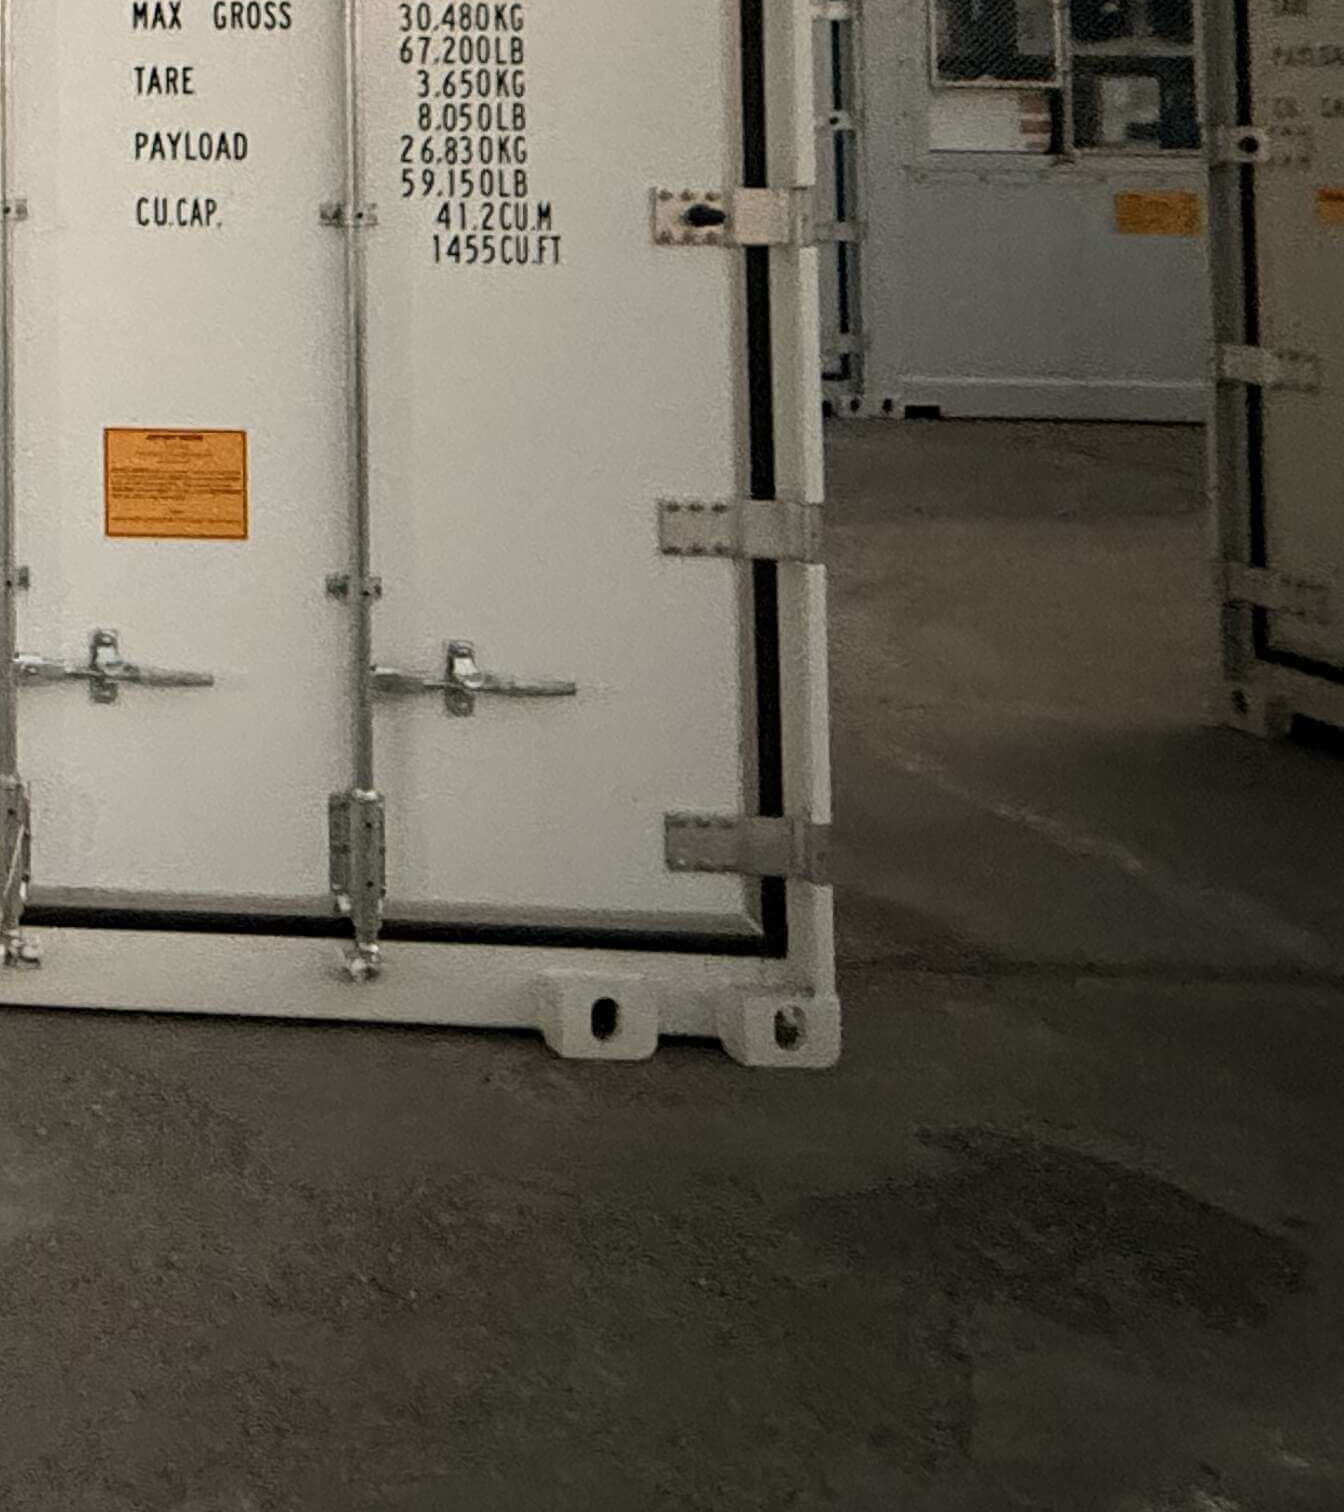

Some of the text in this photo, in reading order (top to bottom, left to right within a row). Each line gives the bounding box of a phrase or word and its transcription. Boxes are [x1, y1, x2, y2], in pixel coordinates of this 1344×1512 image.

[133, 2, 181, 29] MAX
[214, 1, 291, 30] GROSS
[134, 67, 194, 95] TARE
[135, 132, 247, 161] PAYLOAD
[137, 197, 221, 227] CU.CAP.
